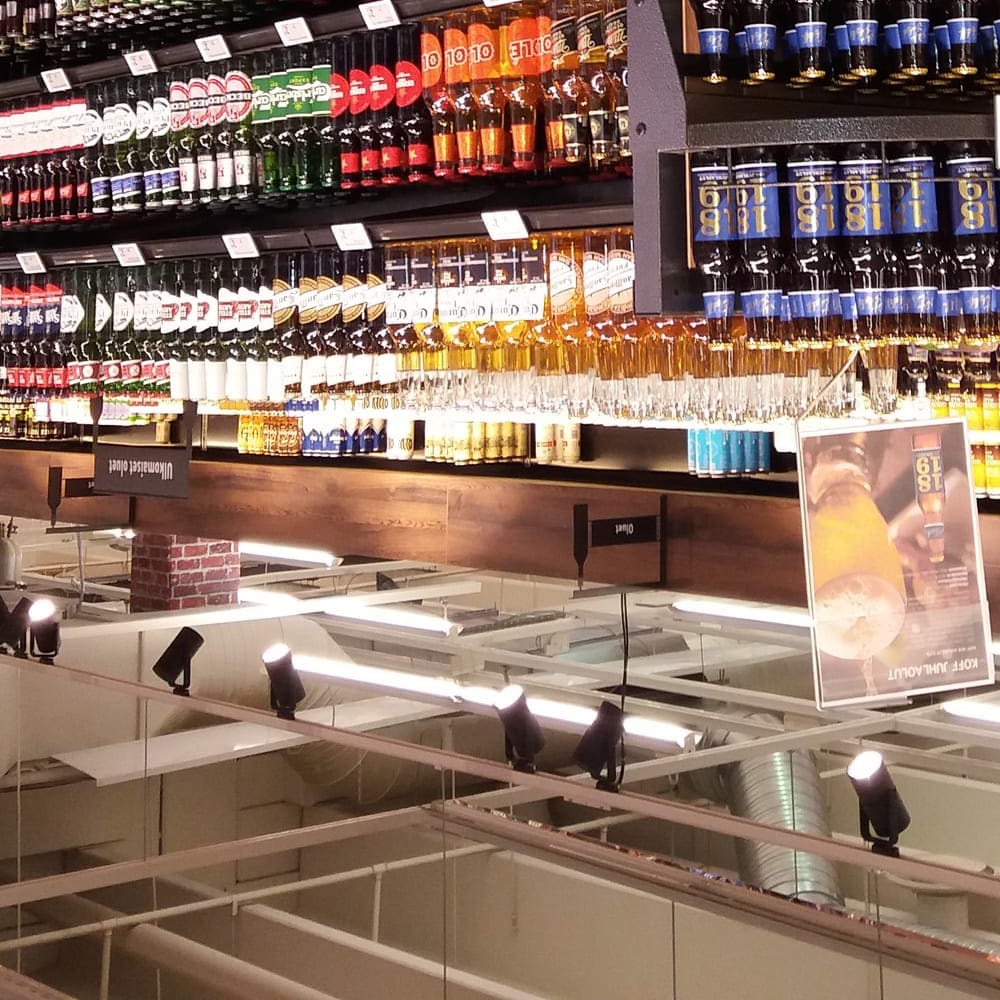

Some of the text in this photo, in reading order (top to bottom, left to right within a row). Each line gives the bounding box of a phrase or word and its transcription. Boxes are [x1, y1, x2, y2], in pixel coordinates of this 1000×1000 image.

[736, 177, 766, 206] 19
[796, 175, 834, 204] 19
[844, 175, 883, 203] 19
[958, 172, 994, 199] 19
[737, 205, 767, 234] 18
[797, 204, 835, 233] 18
[845, 203, 884, 231] 18
[961, 200, 996, 230] 18
[108, 459, 173, 480] Ulkomaiset oluet
[916, 455, 942, 474] 19
[917, 473, 942, 492] 18
[615, 522, 634, 536] Oluet
[888, 657, 978, 680] KOFF JUHLAOLUT
